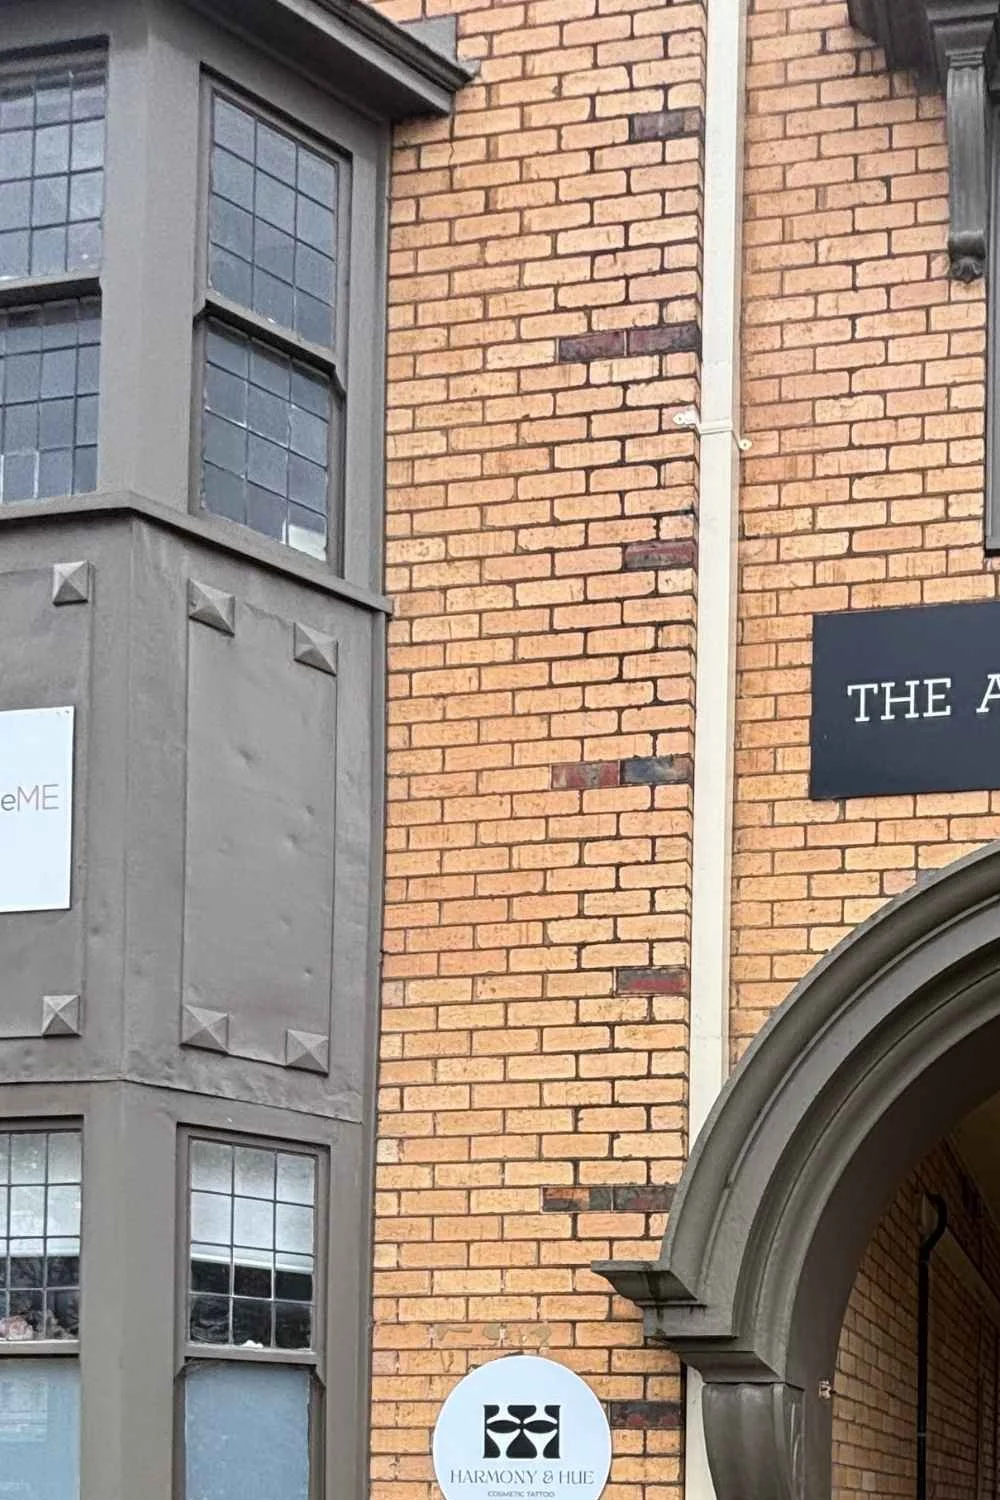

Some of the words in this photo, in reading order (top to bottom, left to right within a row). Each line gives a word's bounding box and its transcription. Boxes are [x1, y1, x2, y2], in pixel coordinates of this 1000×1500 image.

[847, 677, 952, 723] THE
[450, 1469, 537, 1485] HARMONY
[542, 1470, 554, 1485] &
[559, 1470, 595, 1485] HUE
